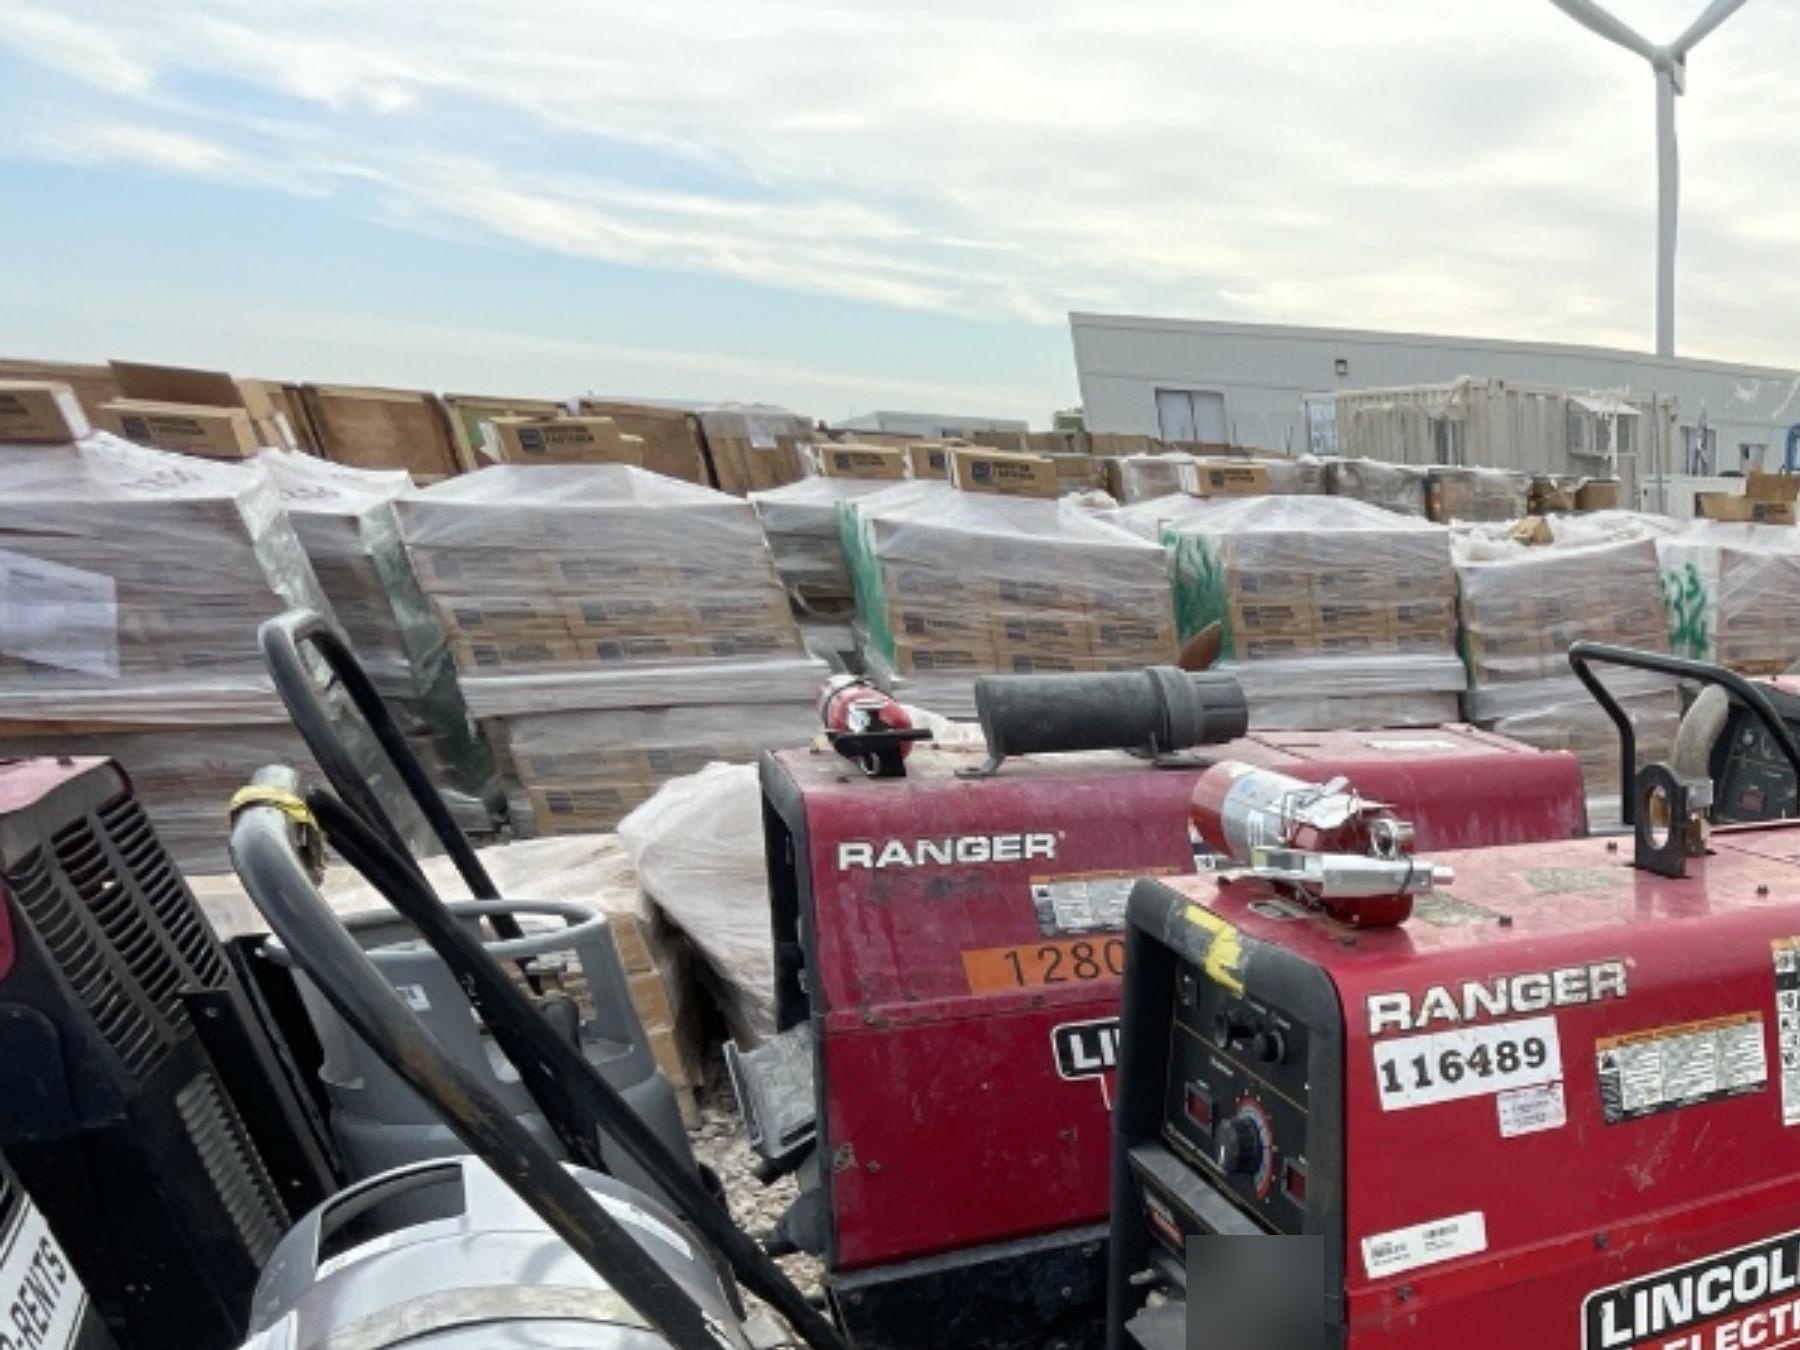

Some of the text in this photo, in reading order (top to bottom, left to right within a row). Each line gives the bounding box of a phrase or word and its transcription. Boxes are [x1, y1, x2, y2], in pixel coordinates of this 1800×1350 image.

[838, 832, 1057, 871] RANGER
[1367, 959, 1629, 1036] RANGER
[1380, 1036, 1547, 1093] 116489
